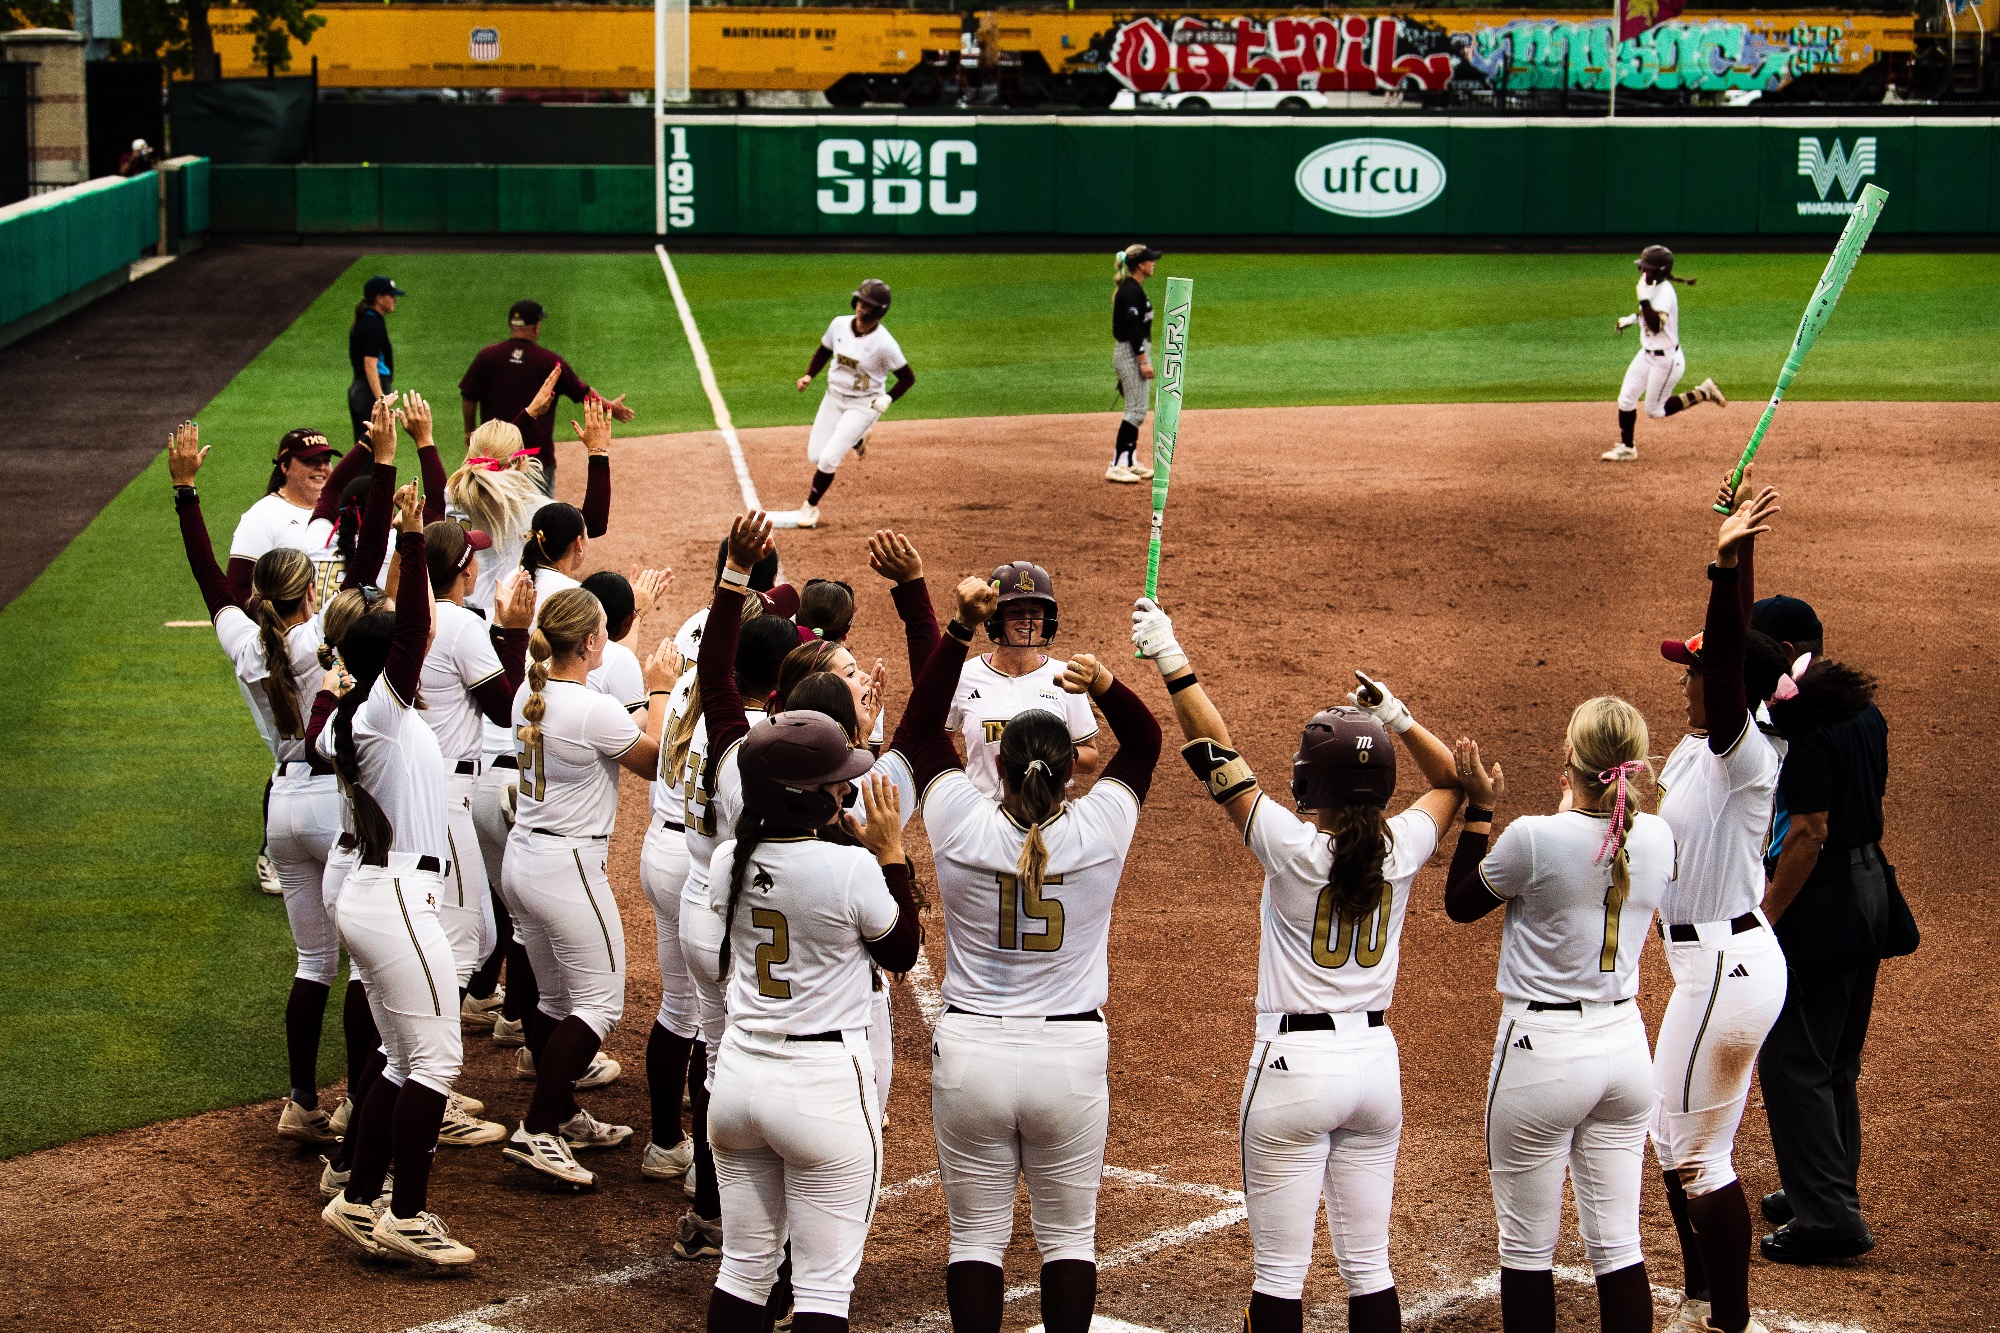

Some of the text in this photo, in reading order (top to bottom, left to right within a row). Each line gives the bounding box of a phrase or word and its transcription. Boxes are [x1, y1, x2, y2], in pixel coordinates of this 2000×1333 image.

[722, 26, 796, 39] MAINTENANCE
[799, 27, 811, 39] OF
[816, 138, 978, 216] SBC
[1323, 155, 1419, 194] ufcu
[516, 723, 547, 803] 21
[995, 870, 1066, 953] 15
[1310, 880, 1394, 969] 00
[751, 907, 793, 1000] 2
